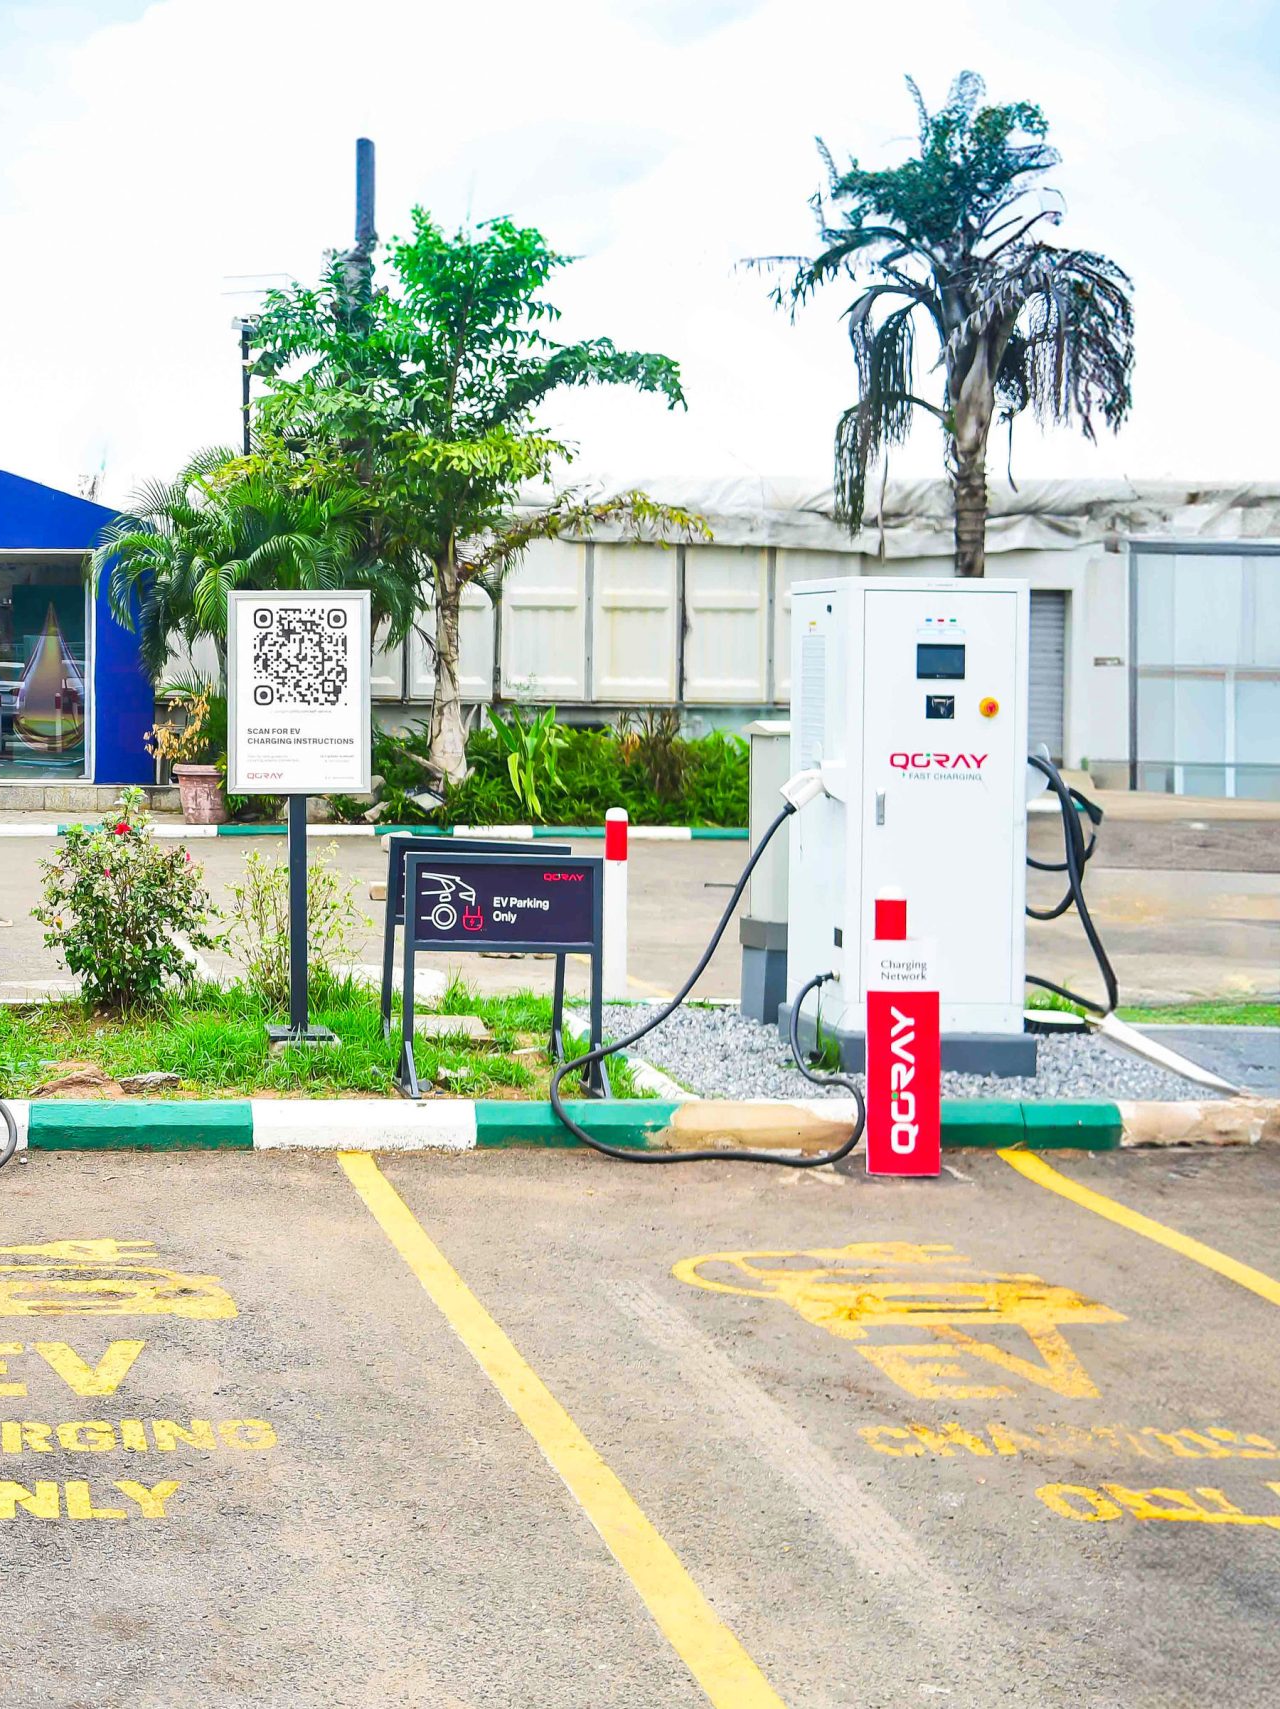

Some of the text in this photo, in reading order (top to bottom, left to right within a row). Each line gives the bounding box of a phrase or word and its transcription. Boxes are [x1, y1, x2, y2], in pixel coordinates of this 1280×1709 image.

[247, 737, 355, 745] CHARGING INSTRUCTIONS
[909, 772, 982, 781] FAST CHARGING
[493, 897, 550, 910] EV Parking
[493, 911, 517, 924] Only
[880, 960, 927, 971] Charging
[881, 971, 927, 981] Network
